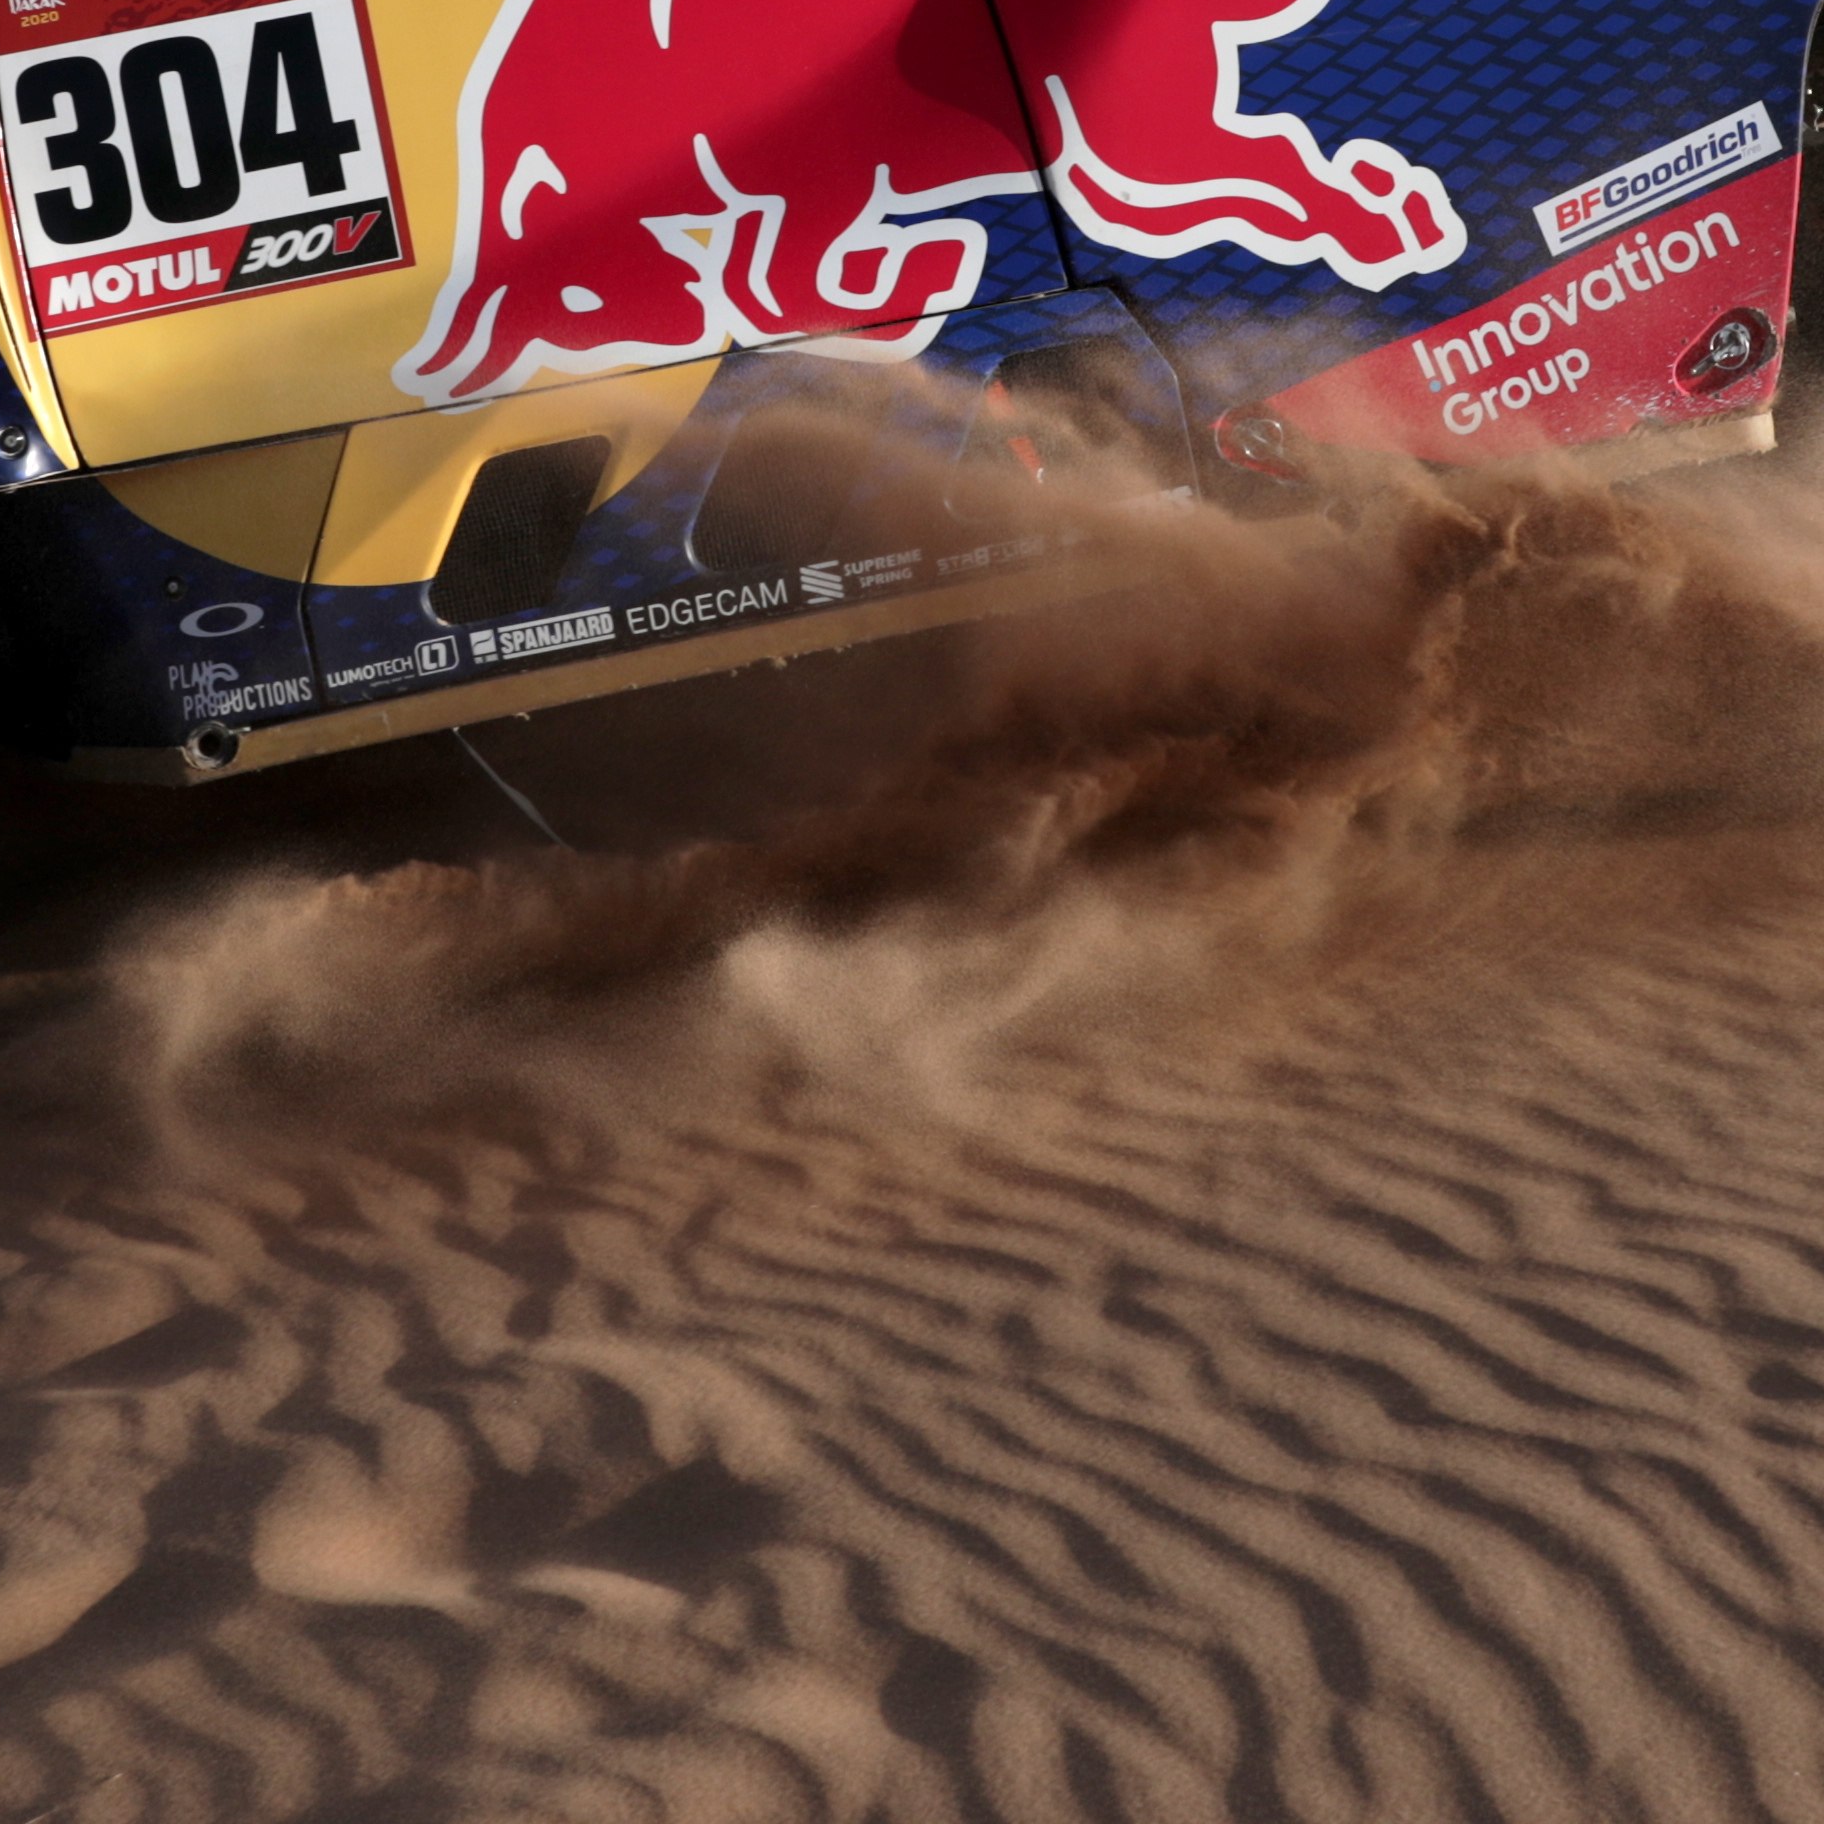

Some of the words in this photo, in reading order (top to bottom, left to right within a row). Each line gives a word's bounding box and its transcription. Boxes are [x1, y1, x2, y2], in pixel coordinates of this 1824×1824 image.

[20, 11, 59, 28] 2020
[15, 12, 361, 245] 304
[1555, 119, 1760, 232] BFGoodrich
[47, 246, 222, 316] MOTUL
[240, 210, 382, 275] 300V
[1412, 211, 1740, 394] Innovation
[1443, 347, 1591, 436] Group
[843, 548, 923, 577] SUPREME
[860, 567, 913, 589] SPRING
[625, 579, 789, 636] EDGECAM
[499, 612, 615, 655] SPANJAARD
[326, 655, 414, 689] LUMOTECH
[183, 676, 313, 721] PRODUCTIONS
